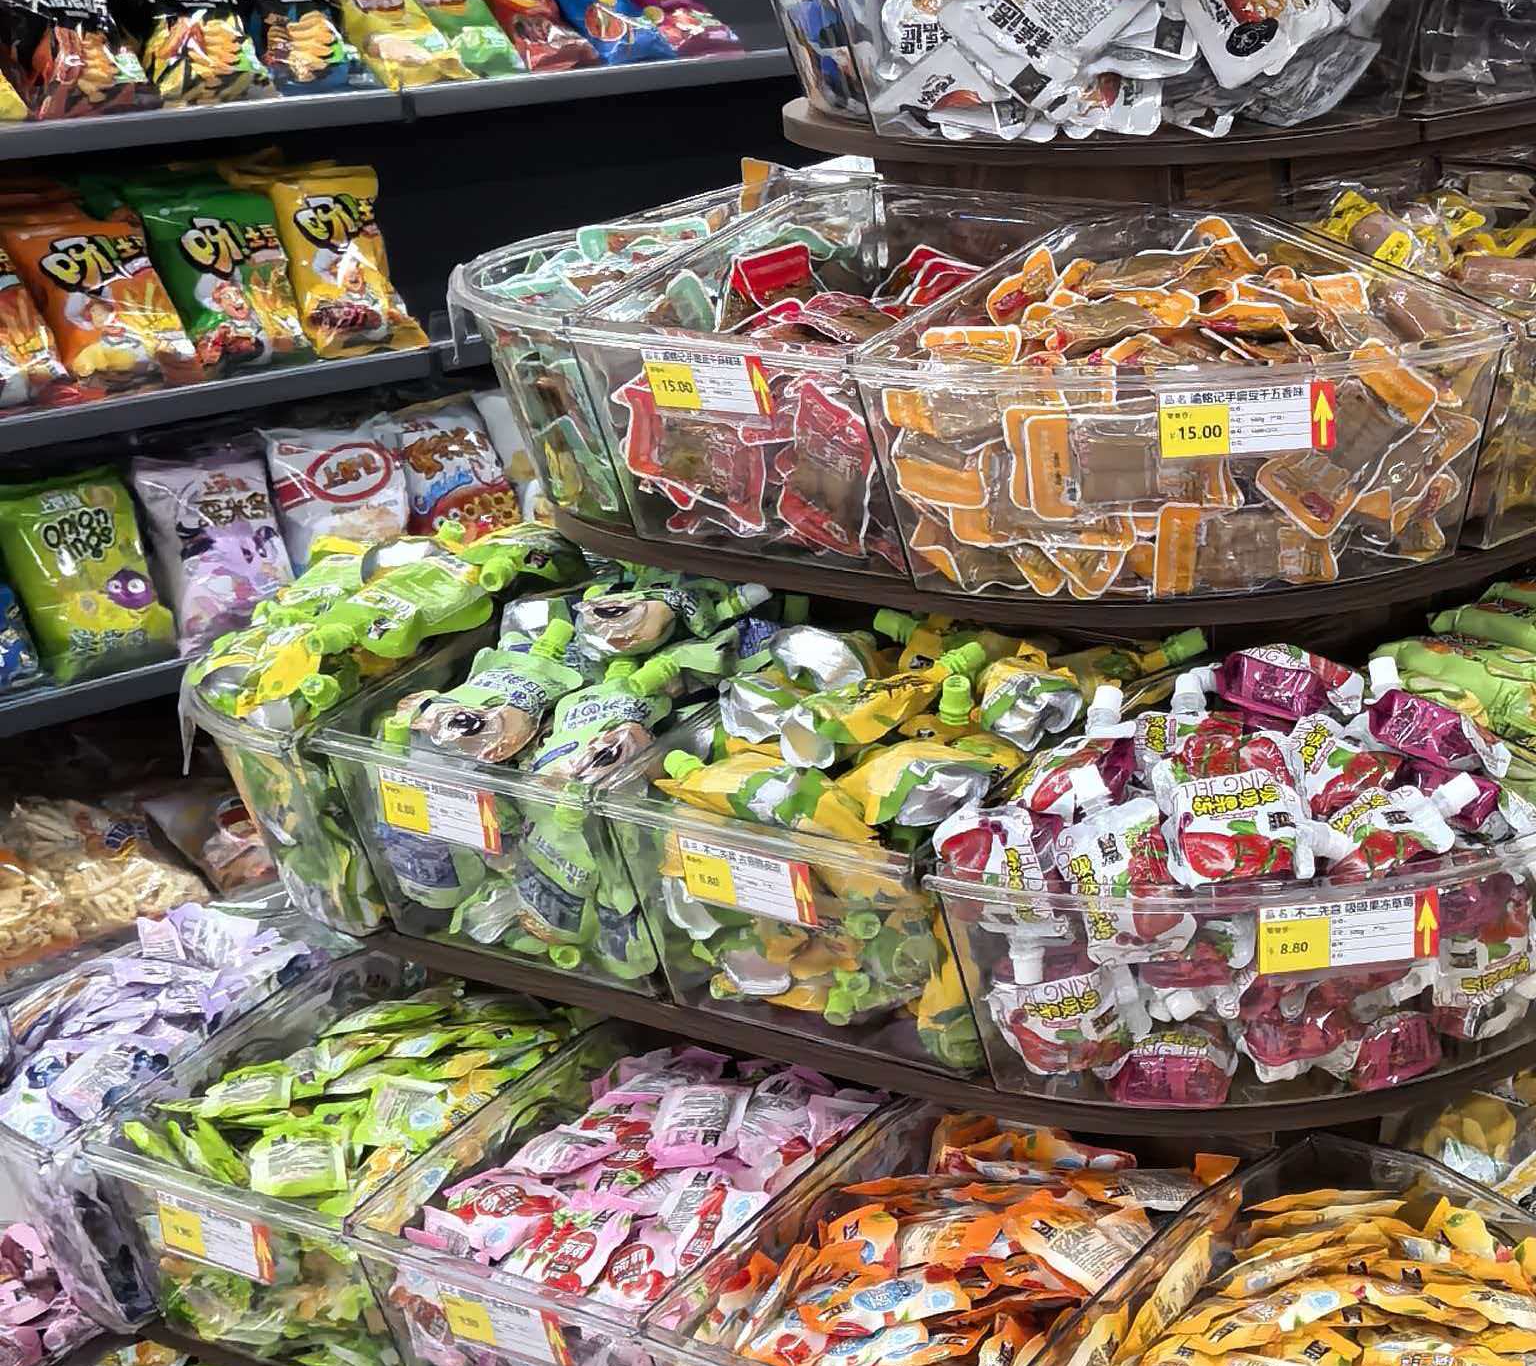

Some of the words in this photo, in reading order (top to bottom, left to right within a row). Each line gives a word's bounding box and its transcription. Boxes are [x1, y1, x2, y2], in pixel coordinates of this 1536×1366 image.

[661, 378, 694, 394] 15.00
[1178, 424, 1223, 441] 15.00
[42, 507, 111, 551] onion
[1280, 940, 1309, 956] 8.80
